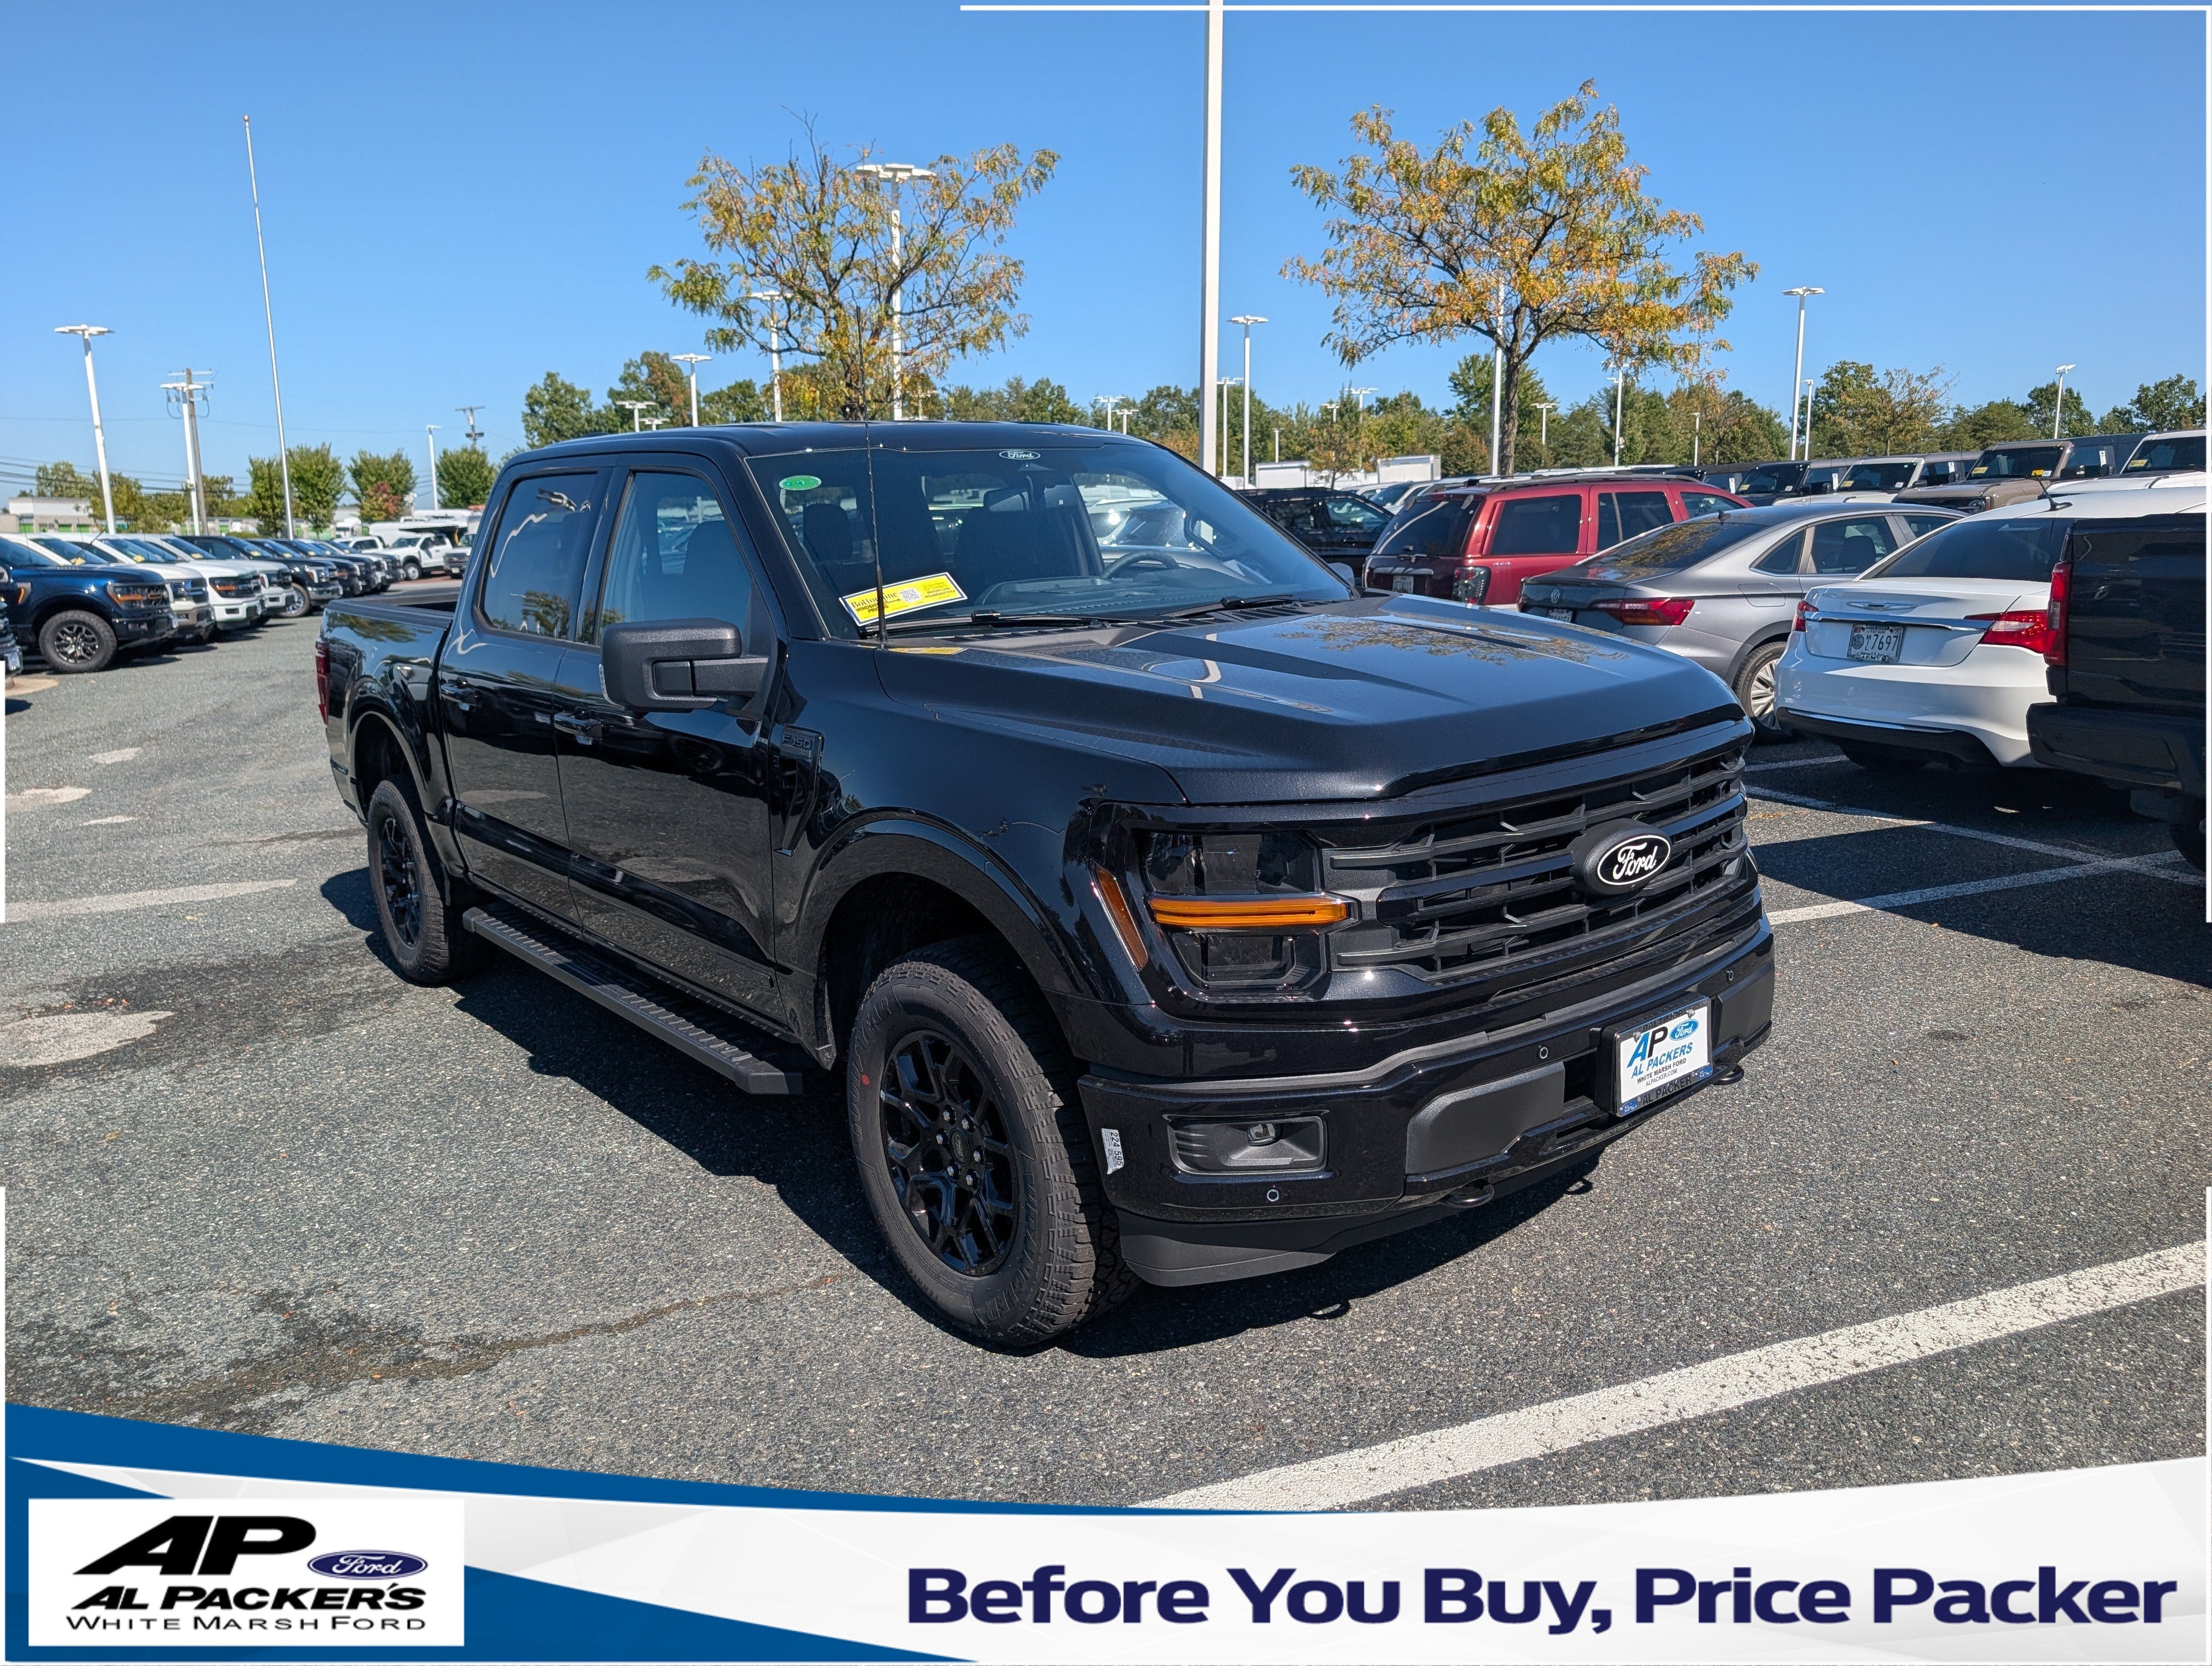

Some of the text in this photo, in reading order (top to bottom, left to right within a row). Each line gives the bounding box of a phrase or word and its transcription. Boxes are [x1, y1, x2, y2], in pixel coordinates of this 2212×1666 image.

[1872, 634, 1899, 651] 7697
[782, 734, 811, 749] F-150
[1612, 842, 1657, 880] Ford
[1626, 1022, 1693, 1069] AP Ford
[1631, 1042, 1693, 1079] AL PACKERS
[1637, 1058, 1687, 1084] WHITE MARSH FORD
[1645, 1068, 1677, 1087] ALPACKER.COM
[1642, 1074, 1692, 1106] AL PACKER
[1110, 1132, 1124, 1167] 224 595
